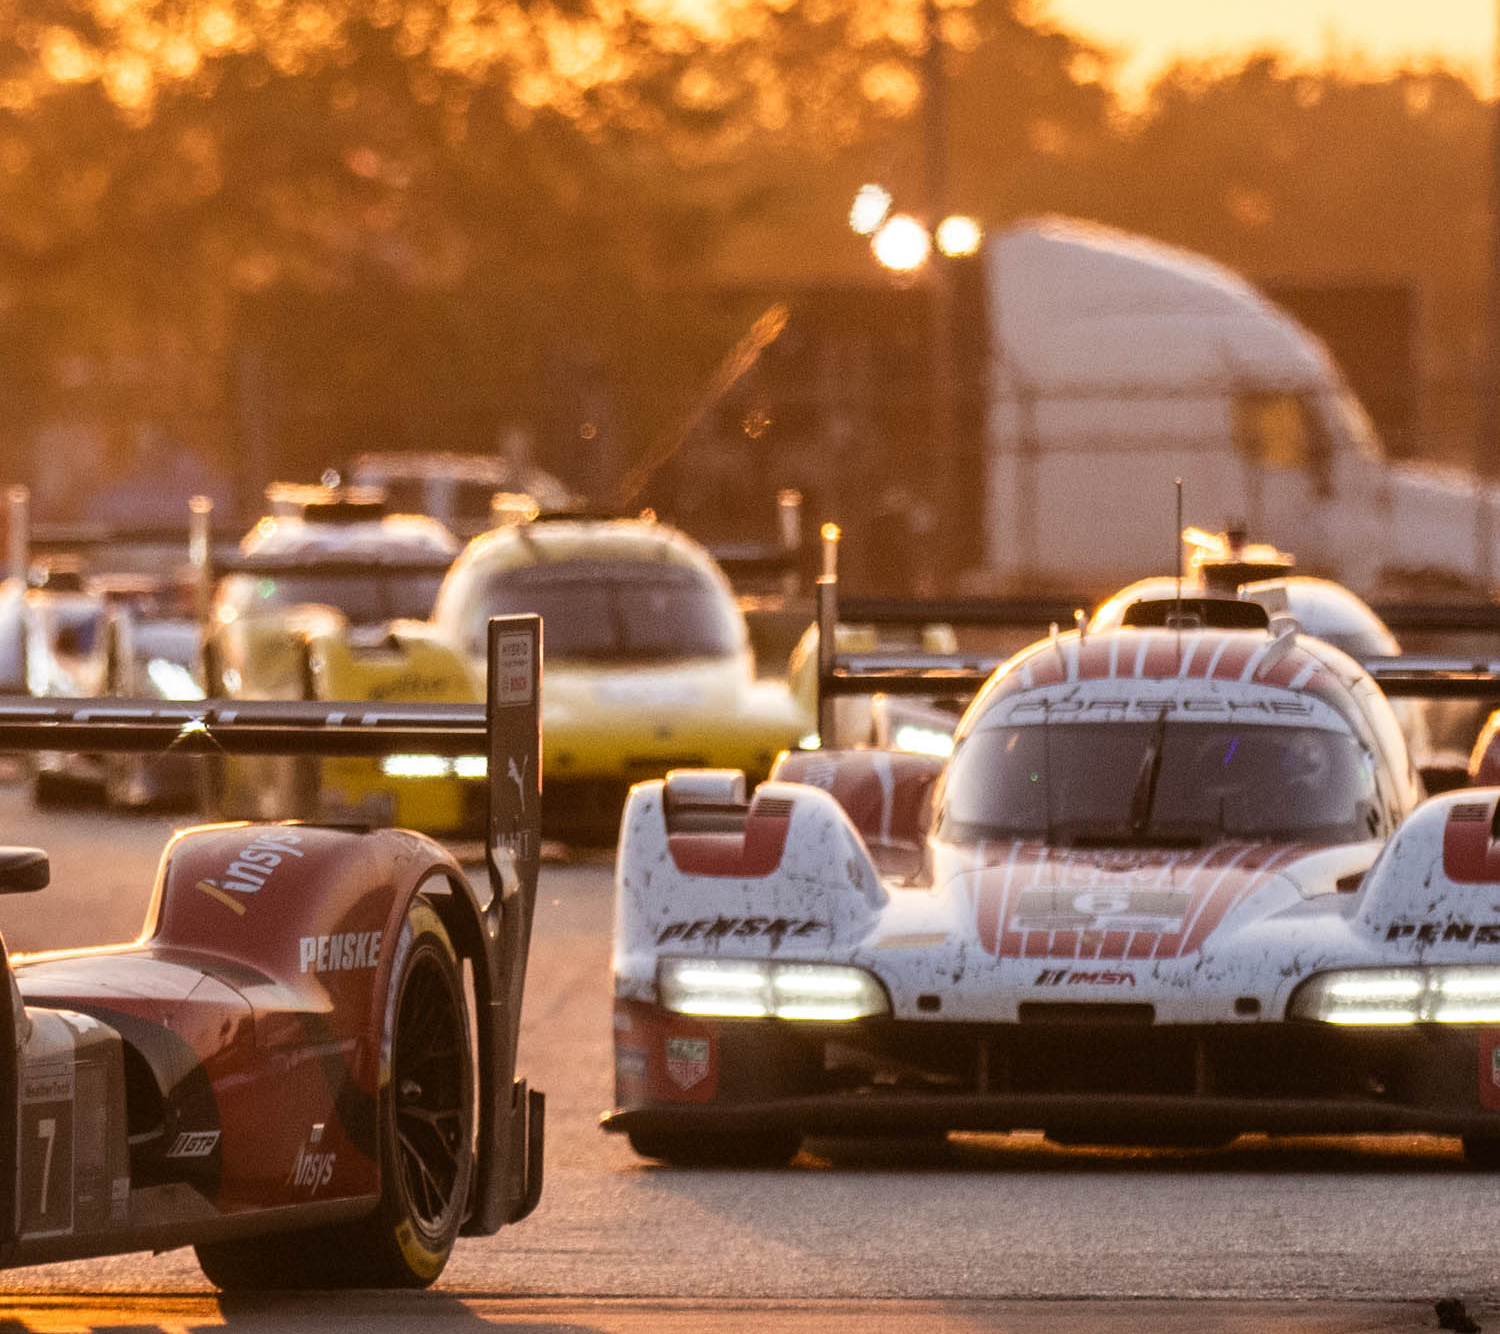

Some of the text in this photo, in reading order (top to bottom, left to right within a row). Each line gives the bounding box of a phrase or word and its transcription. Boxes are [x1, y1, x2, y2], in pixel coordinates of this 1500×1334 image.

[196, 834, 304, 915] Ansys
[299, 931, 383, 974] PENSKE
[1067, 970, 1136, 987] IMSA
[37, 1118, 56, 1214] 7
[186, 1135, 215, 1153] GTP
[286, 1145, 337, 1196] Ansys
